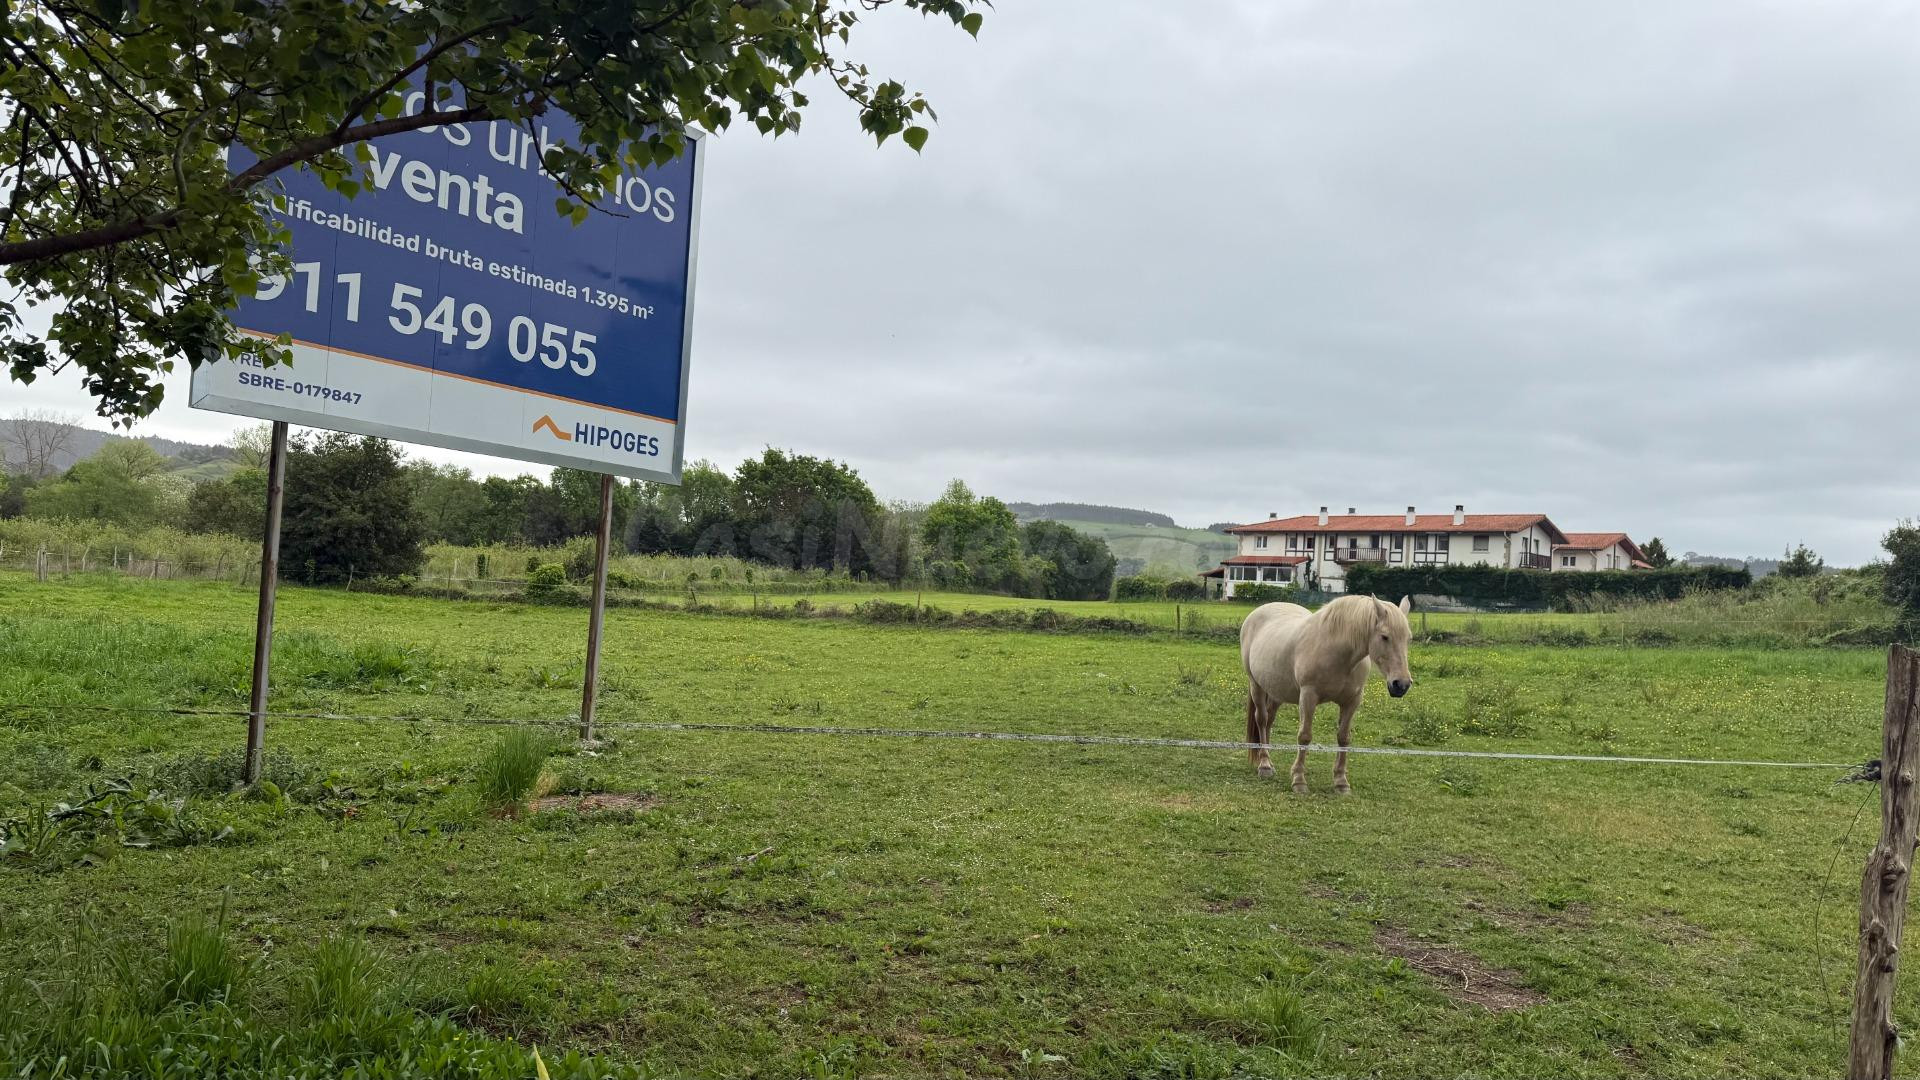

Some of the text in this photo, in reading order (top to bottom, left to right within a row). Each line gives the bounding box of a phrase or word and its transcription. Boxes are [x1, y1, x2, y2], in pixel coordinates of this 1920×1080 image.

[367, 144, 523, 234] venta
[425, 237, 483, 271] bruta
[488, 262, 577, 299] estimada
[582, 287, 629, 315] 1.395
[389, 283, 491, 350] 549
[509, 316, 597, 376] 055
[239, 371, 361, 404] SBRE-0179847
[576, 421, 659, 457] HIPOGES
